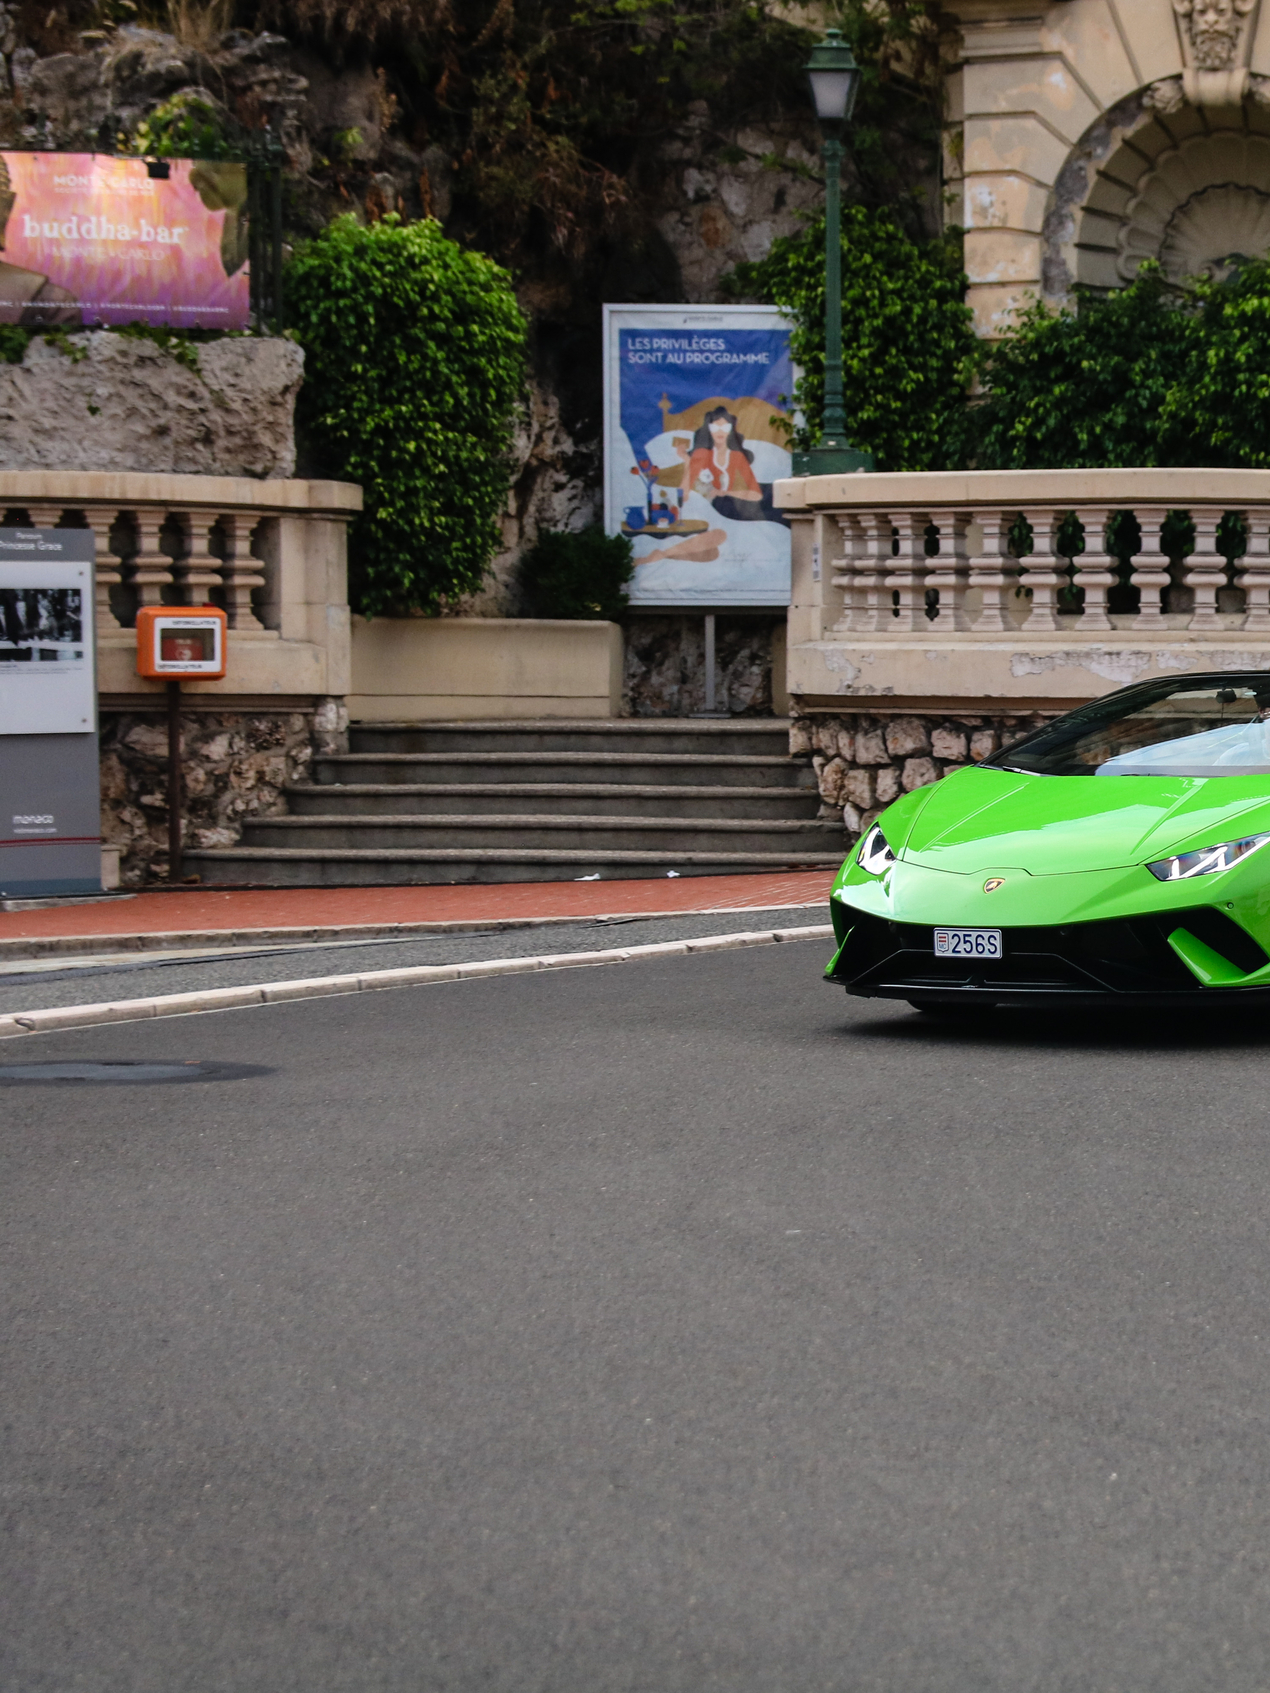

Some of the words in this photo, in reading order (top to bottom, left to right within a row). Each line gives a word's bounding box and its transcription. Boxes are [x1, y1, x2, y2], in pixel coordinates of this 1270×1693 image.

[23, 214, 184, 244] buddha-bar
[628, 338, 651, 350] LES
[653, 335, 725, 350] PRIVILÈGES
[628, 352, 663, 364] SONT
[666, 353, 683, 364] AU
[686, 353, 770, 364] PROGRAMME
[951, 933, 998, 955] 256S
